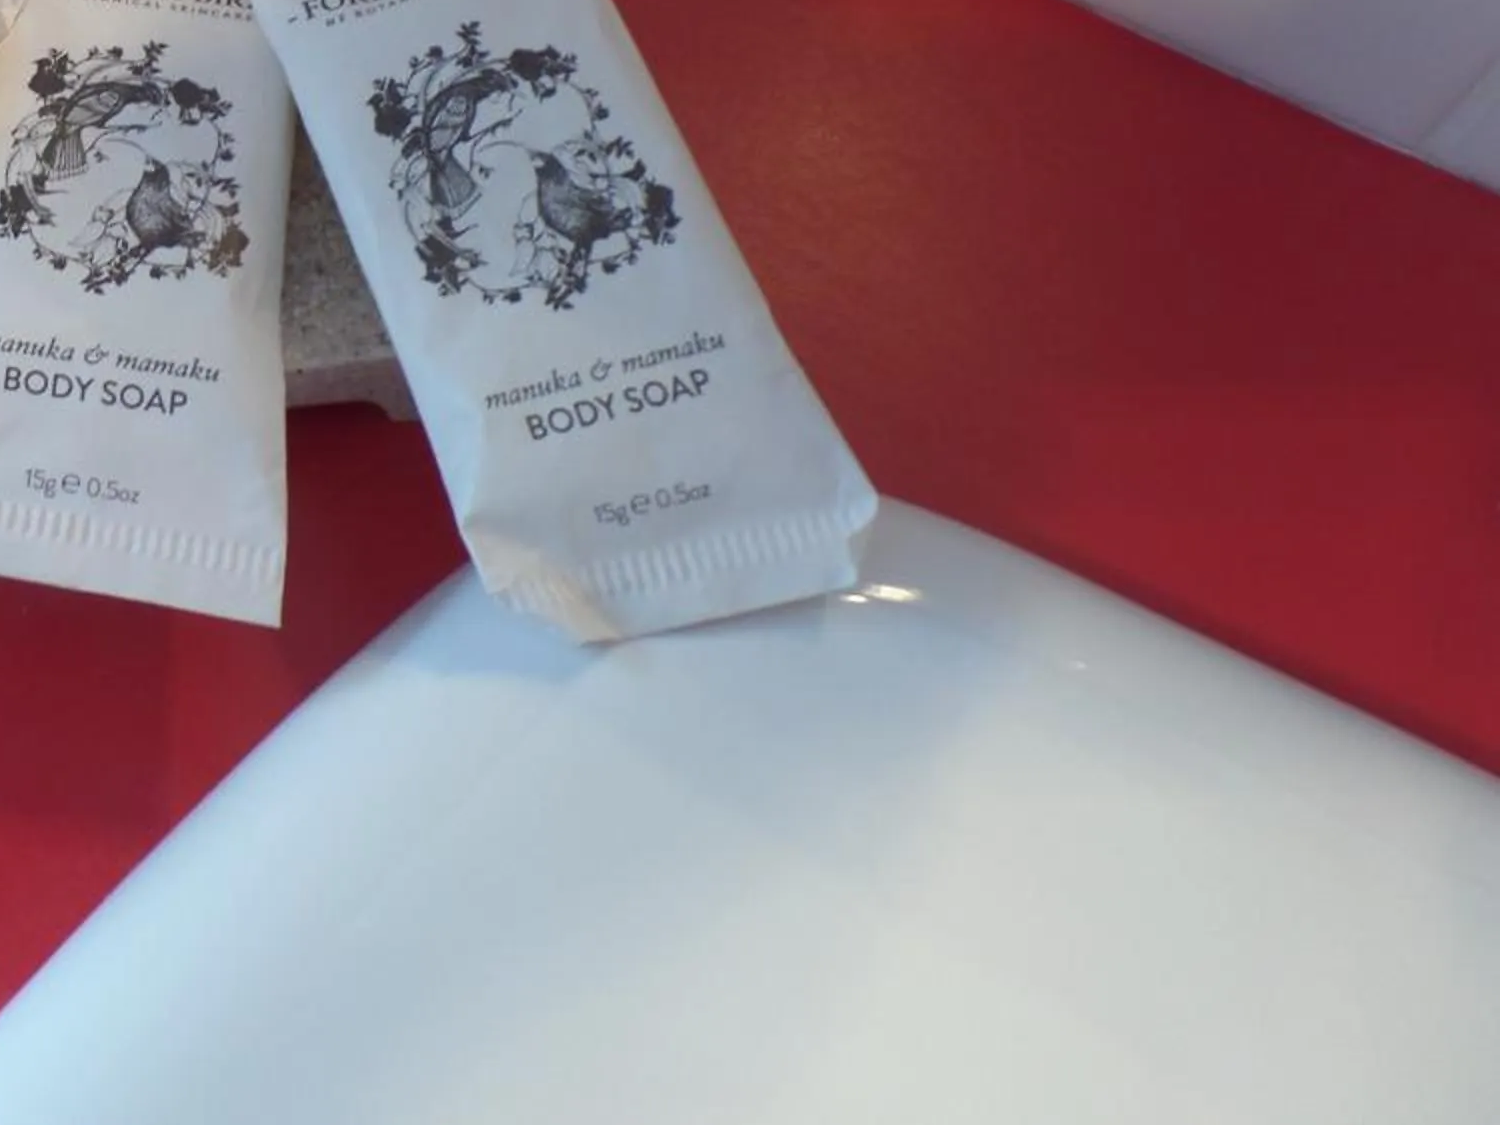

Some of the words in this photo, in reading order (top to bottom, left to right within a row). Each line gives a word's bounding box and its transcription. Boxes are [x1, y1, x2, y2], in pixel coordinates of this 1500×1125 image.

[83, 342, 111, 365] &
[114, 351, 222, 384] mamaku
[483, 367, 583, 411] manuka
[589, 356, 615, 383] &
[620, 330, 727, 376] mamaku
[2, 365, 96, 403] BODY
[99, 378, 189, 417] SOAP
[524, 390, 616, 442] BODY
[621, 367, 711, 414] SOAP
[24, 467, 58, 500] 15g
[85, 476, 142, 505] 0.5oz
[592, 501, 631, 527] 15g
[654, 480, 713, 510] 0.5oz
